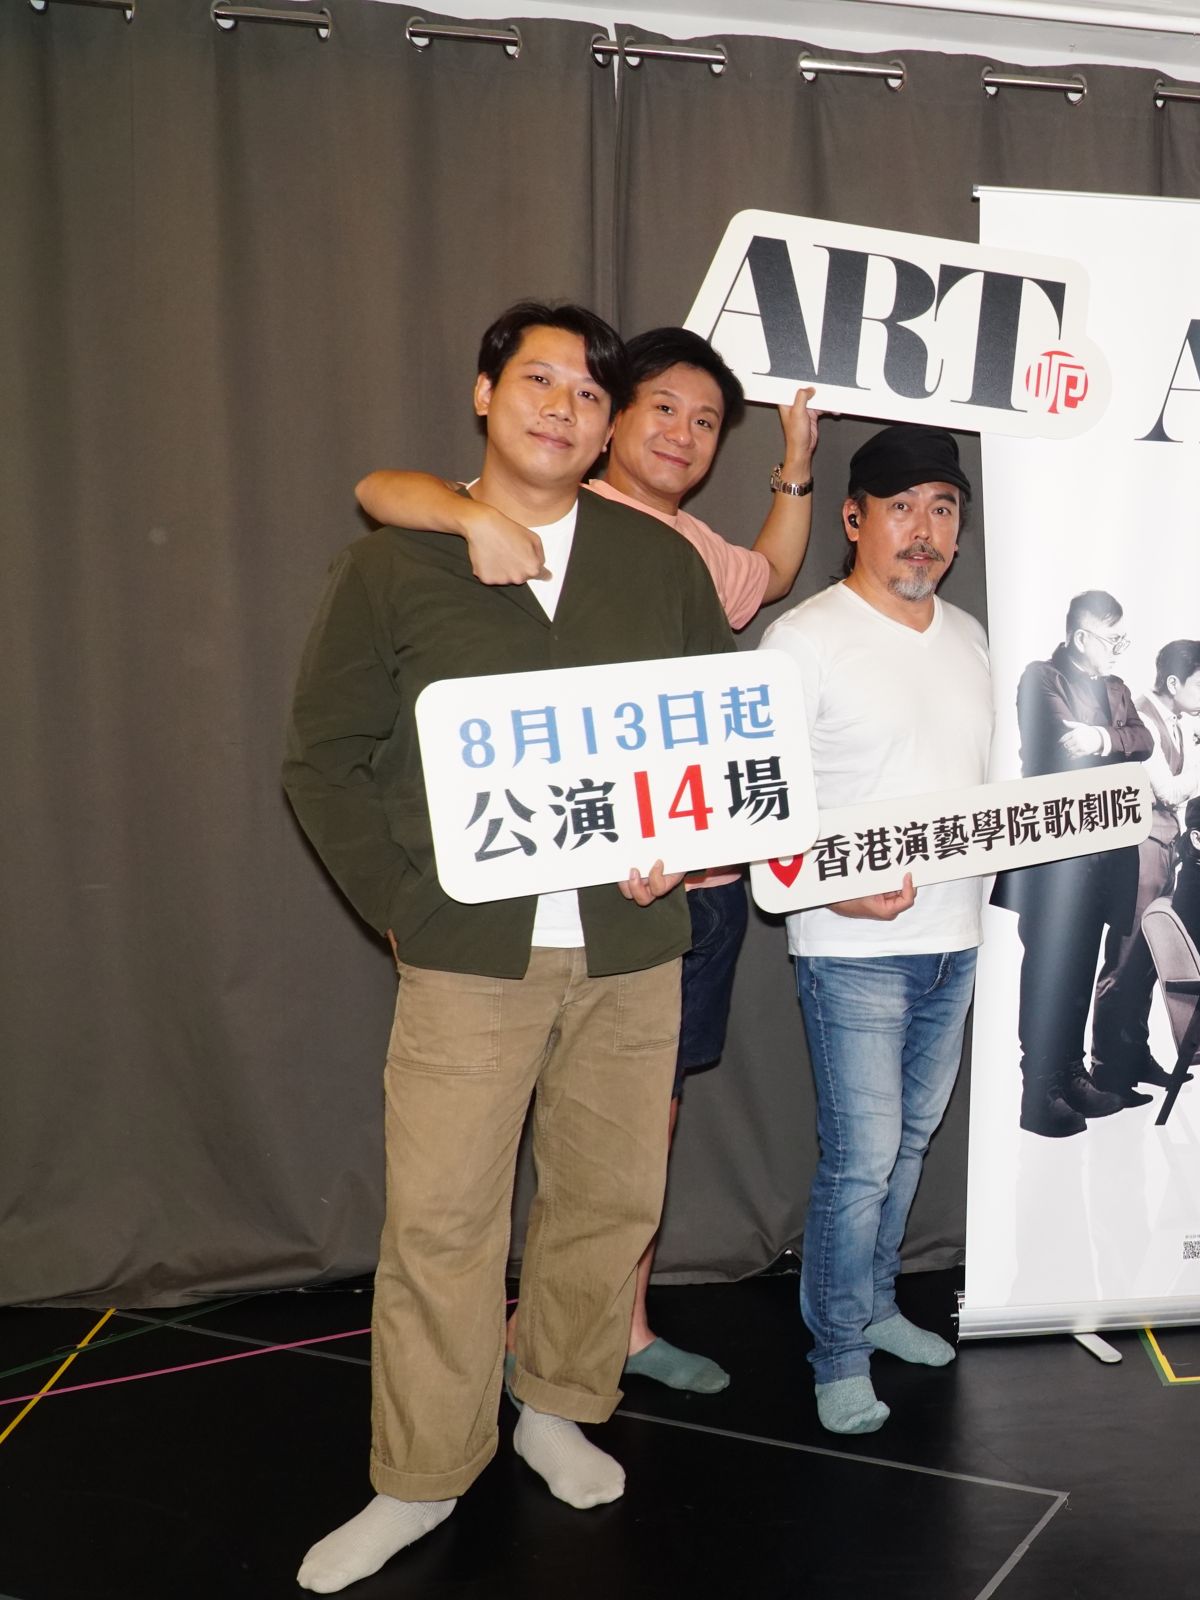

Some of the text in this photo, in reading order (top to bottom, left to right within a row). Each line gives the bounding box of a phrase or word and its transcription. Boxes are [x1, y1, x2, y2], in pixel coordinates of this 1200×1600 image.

[706, 235, 1066, 413] ART
[458, 683, 777, 769] 8月13日起
[464, 756, 790, 864] 公演14場
[813, 785, 1142, 882] 香港演藝學院歌劇院
